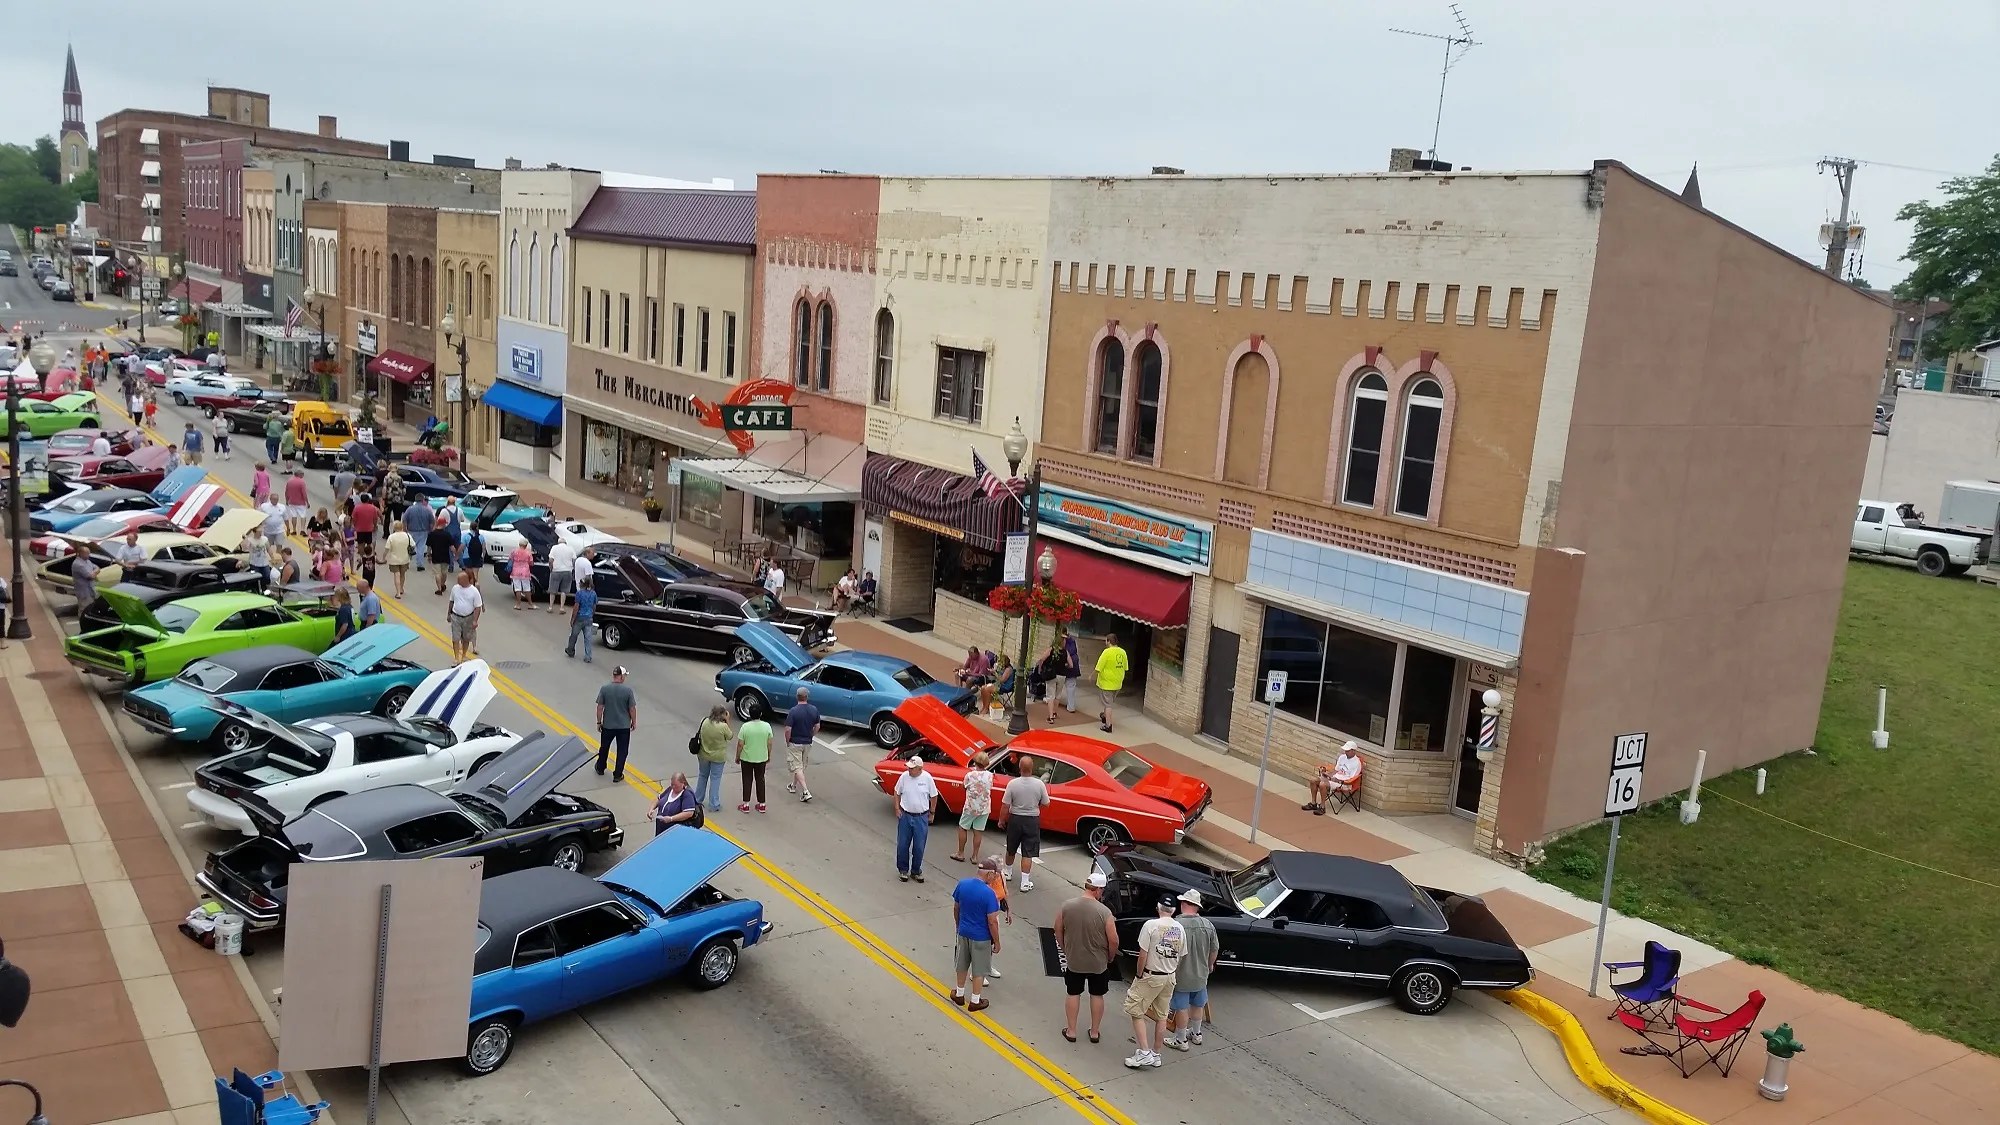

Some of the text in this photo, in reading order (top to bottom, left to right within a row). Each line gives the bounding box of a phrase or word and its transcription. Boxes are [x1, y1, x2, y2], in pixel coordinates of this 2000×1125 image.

[594, 367, 617, 394] THE
[751, 394, 784, 402] PORTAGE
[733, 409, 785, 426] CAFE
[1110, 511, 1150, 533] HOMECARE
[1150, 521, 1170, 538] PLUS
[1169, 526, 1187, 543] LLC
[1616, 738, 1644, 762] JCT
[1613, 776, 1634, 804] 16
